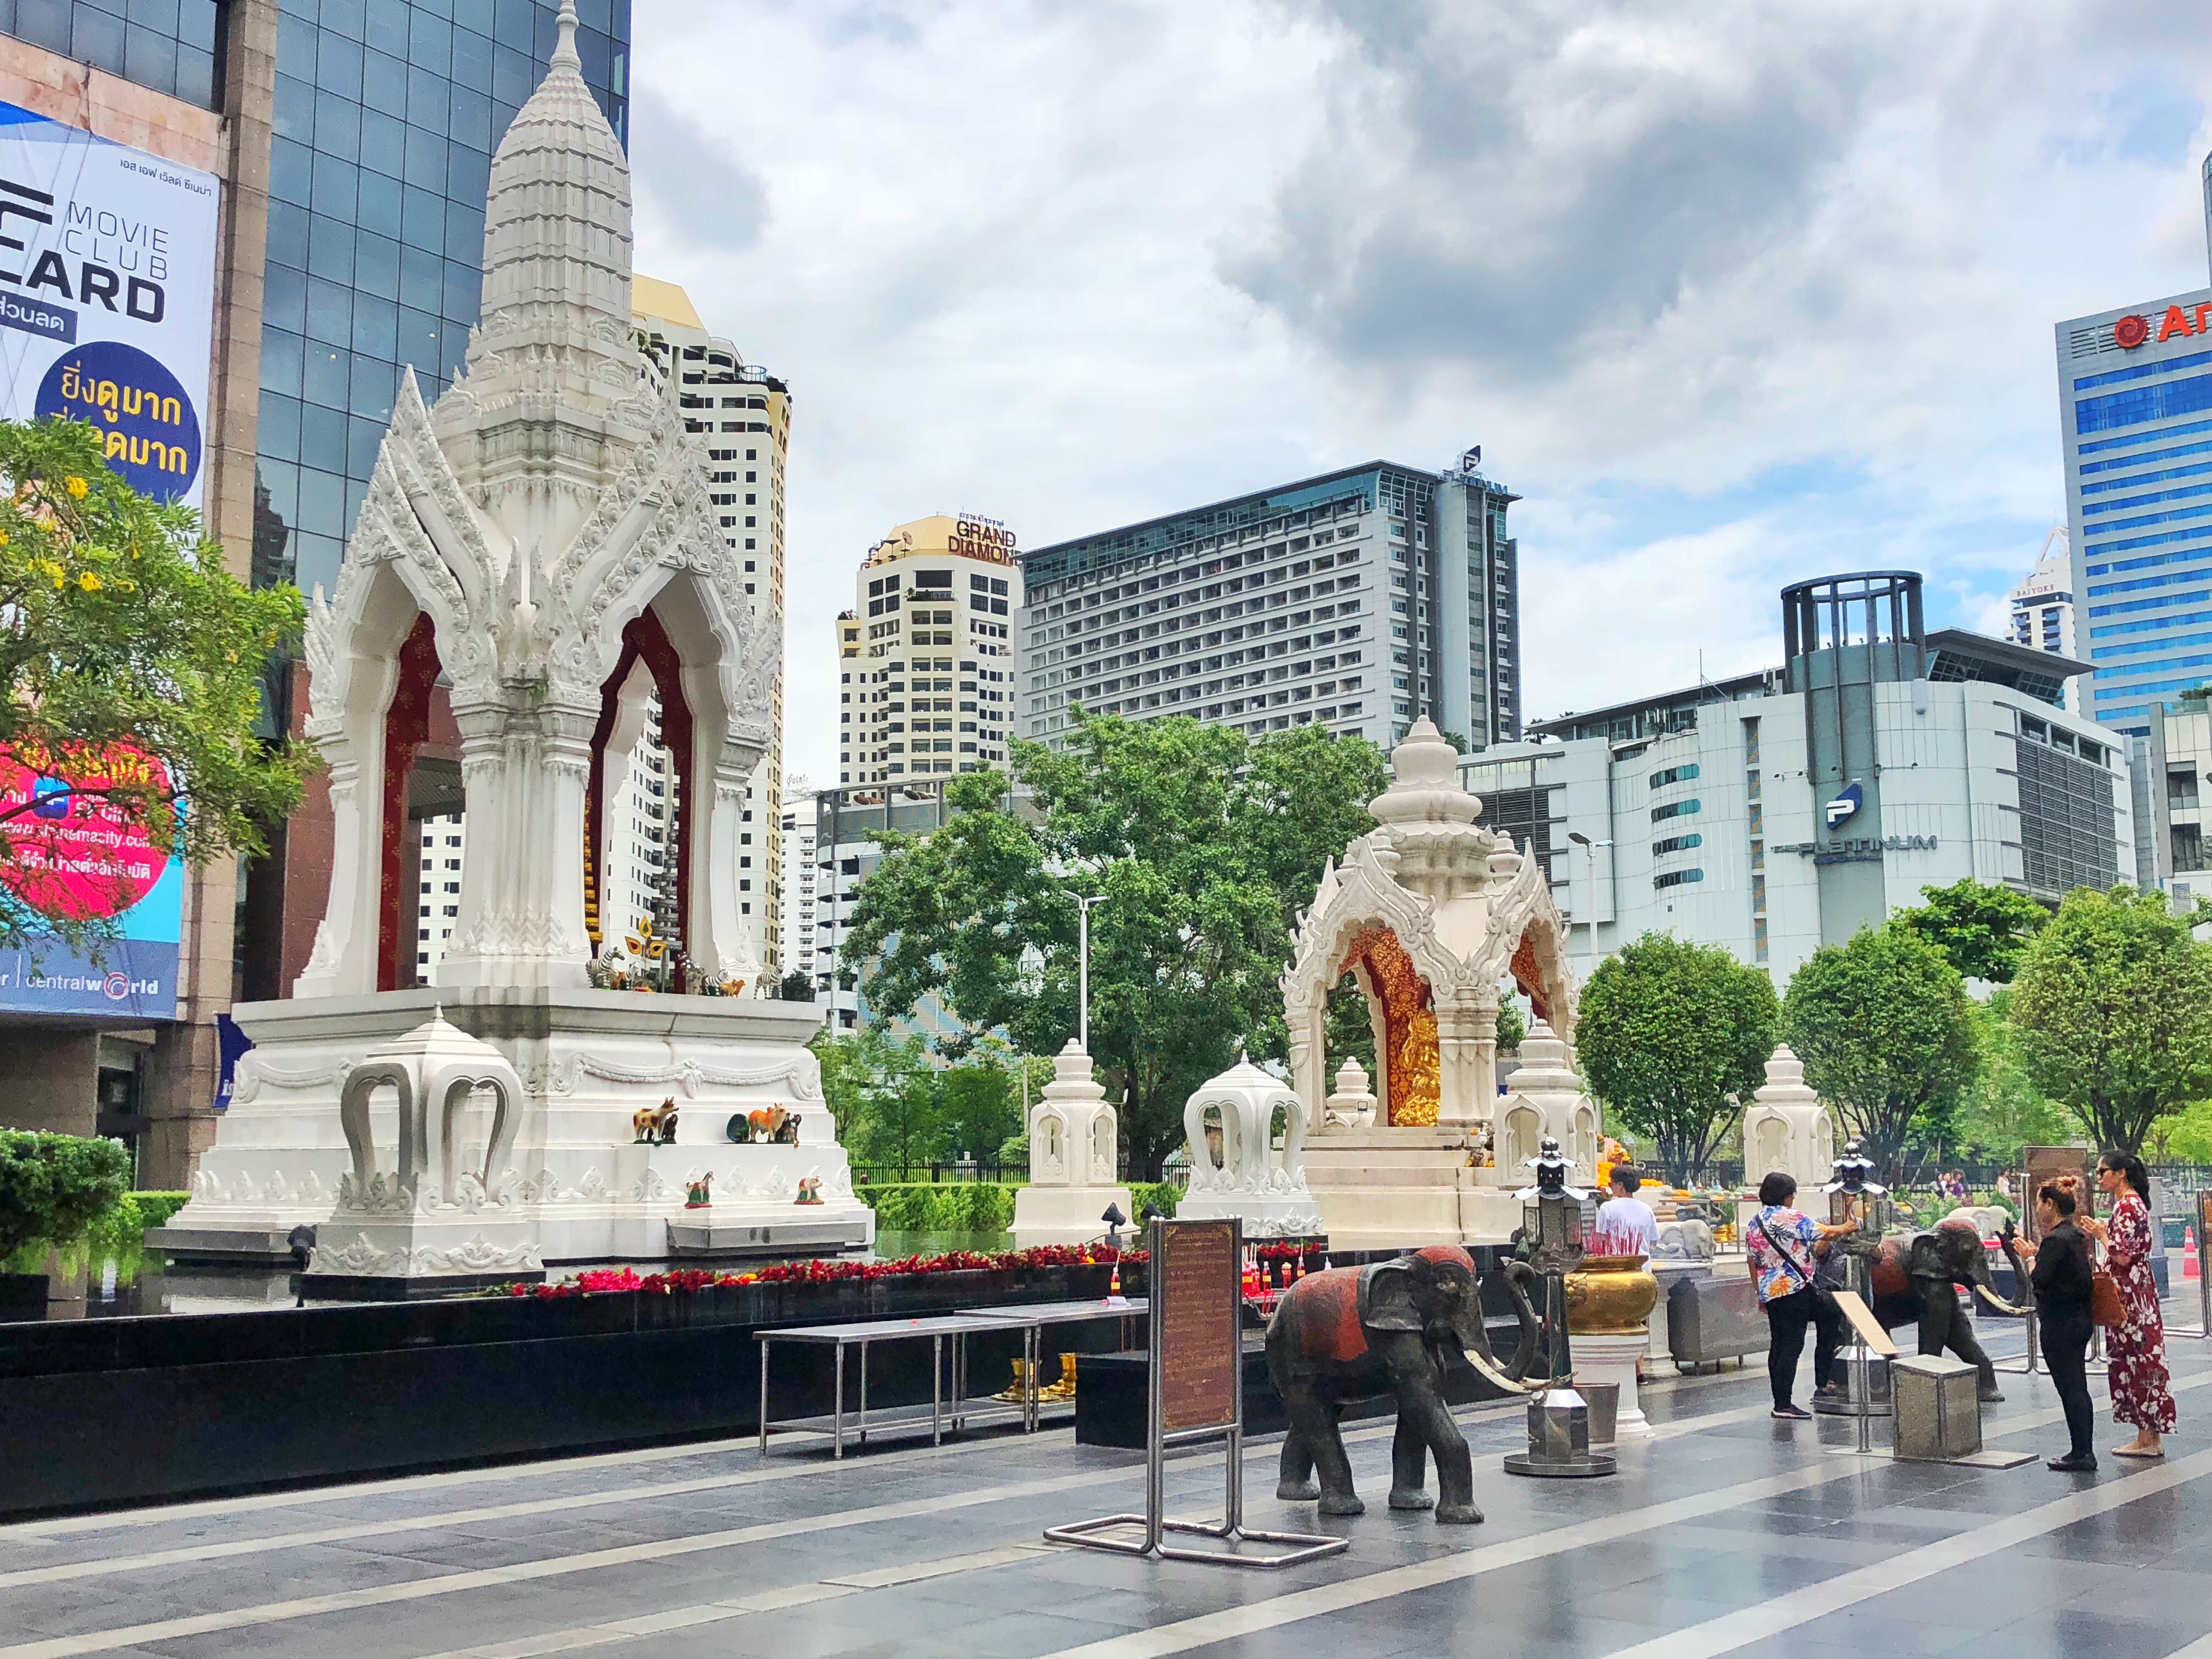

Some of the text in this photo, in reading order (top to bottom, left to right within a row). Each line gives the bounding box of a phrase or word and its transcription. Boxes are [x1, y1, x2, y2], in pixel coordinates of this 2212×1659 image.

[120, 159, 137, 171] เอส
[139, 166, 157, 178] เอฟ
[69, 201, 168, 254] MOVIE
[66, 229, 167, 280] CLUB
[61, 360, 181, 426] ยิ่งดูมาก
[957, 521, 1016, 548] GRAND
[949, 535, 1016, 567] DIAMON
[2017, 584, 2054, 597] BAIYOKE
